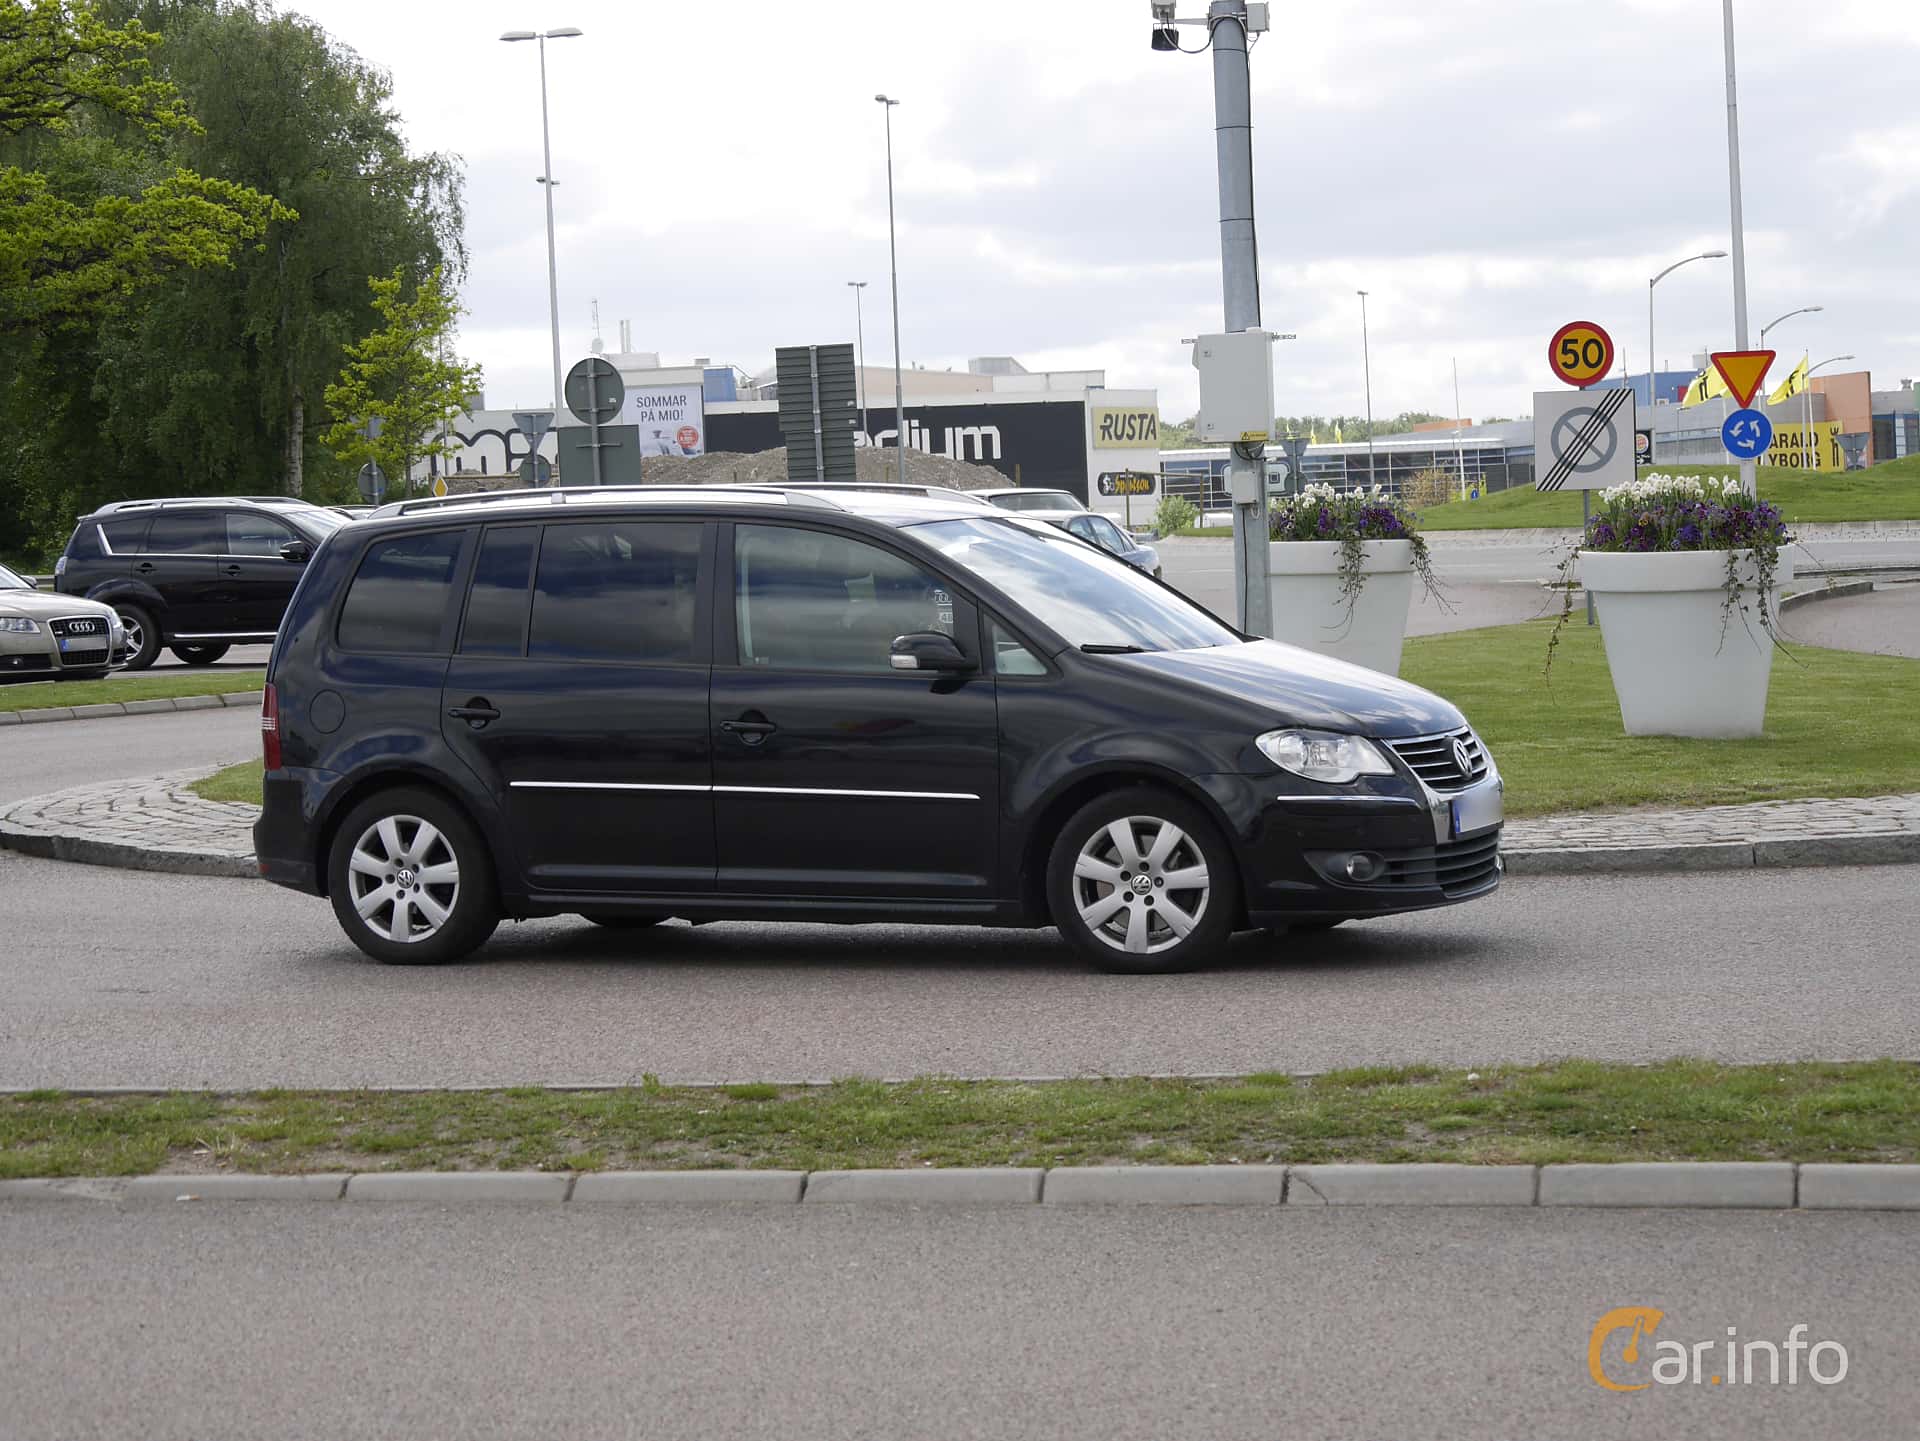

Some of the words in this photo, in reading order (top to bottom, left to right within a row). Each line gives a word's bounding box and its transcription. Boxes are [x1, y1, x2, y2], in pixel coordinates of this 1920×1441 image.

[1561, 338, 1604, 369] 50
[636, 395, 687, 409] SOMMAR
[641, 408, 655, 423] PÅ
[658, 409, 684, 422] MIO!
[1100, 413, 1157, 441] RUSTA
[1768, 432, 1819, 449] ARALD
[1757, 451, 1822, 469] YBORG
